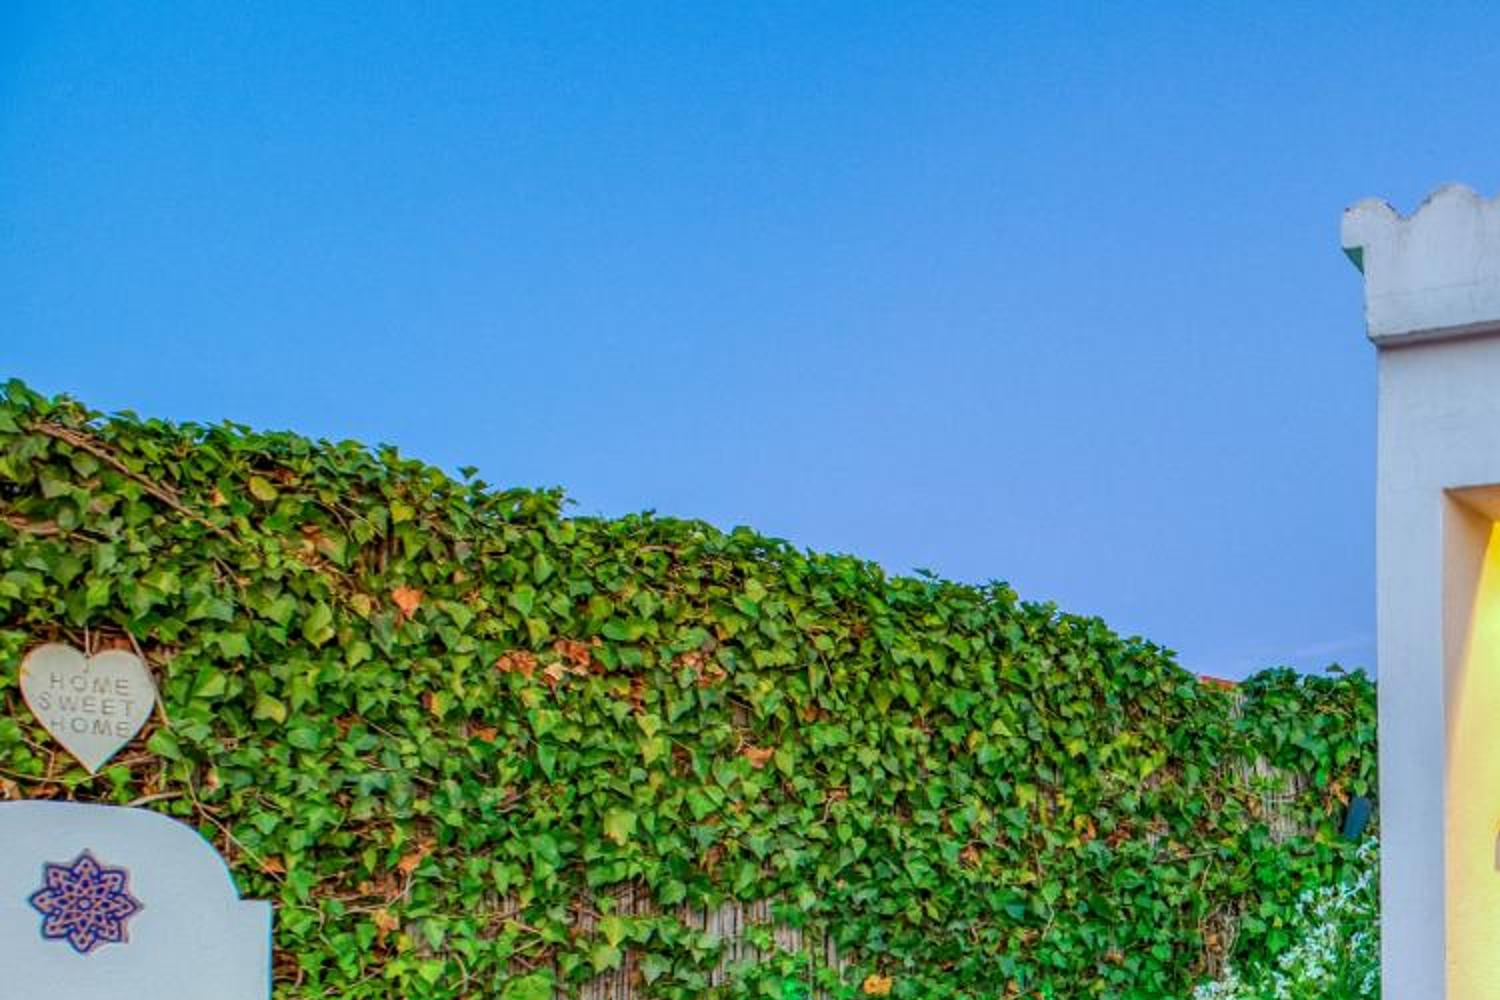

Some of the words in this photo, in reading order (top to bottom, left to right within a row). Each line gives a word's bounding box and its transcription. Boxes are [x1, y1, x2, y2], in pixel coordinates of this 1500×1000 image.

[50, 672, 129, 697] HOME
[37, 691, 134, 717] SWEET
[51, 717, 131, 739] HOME
